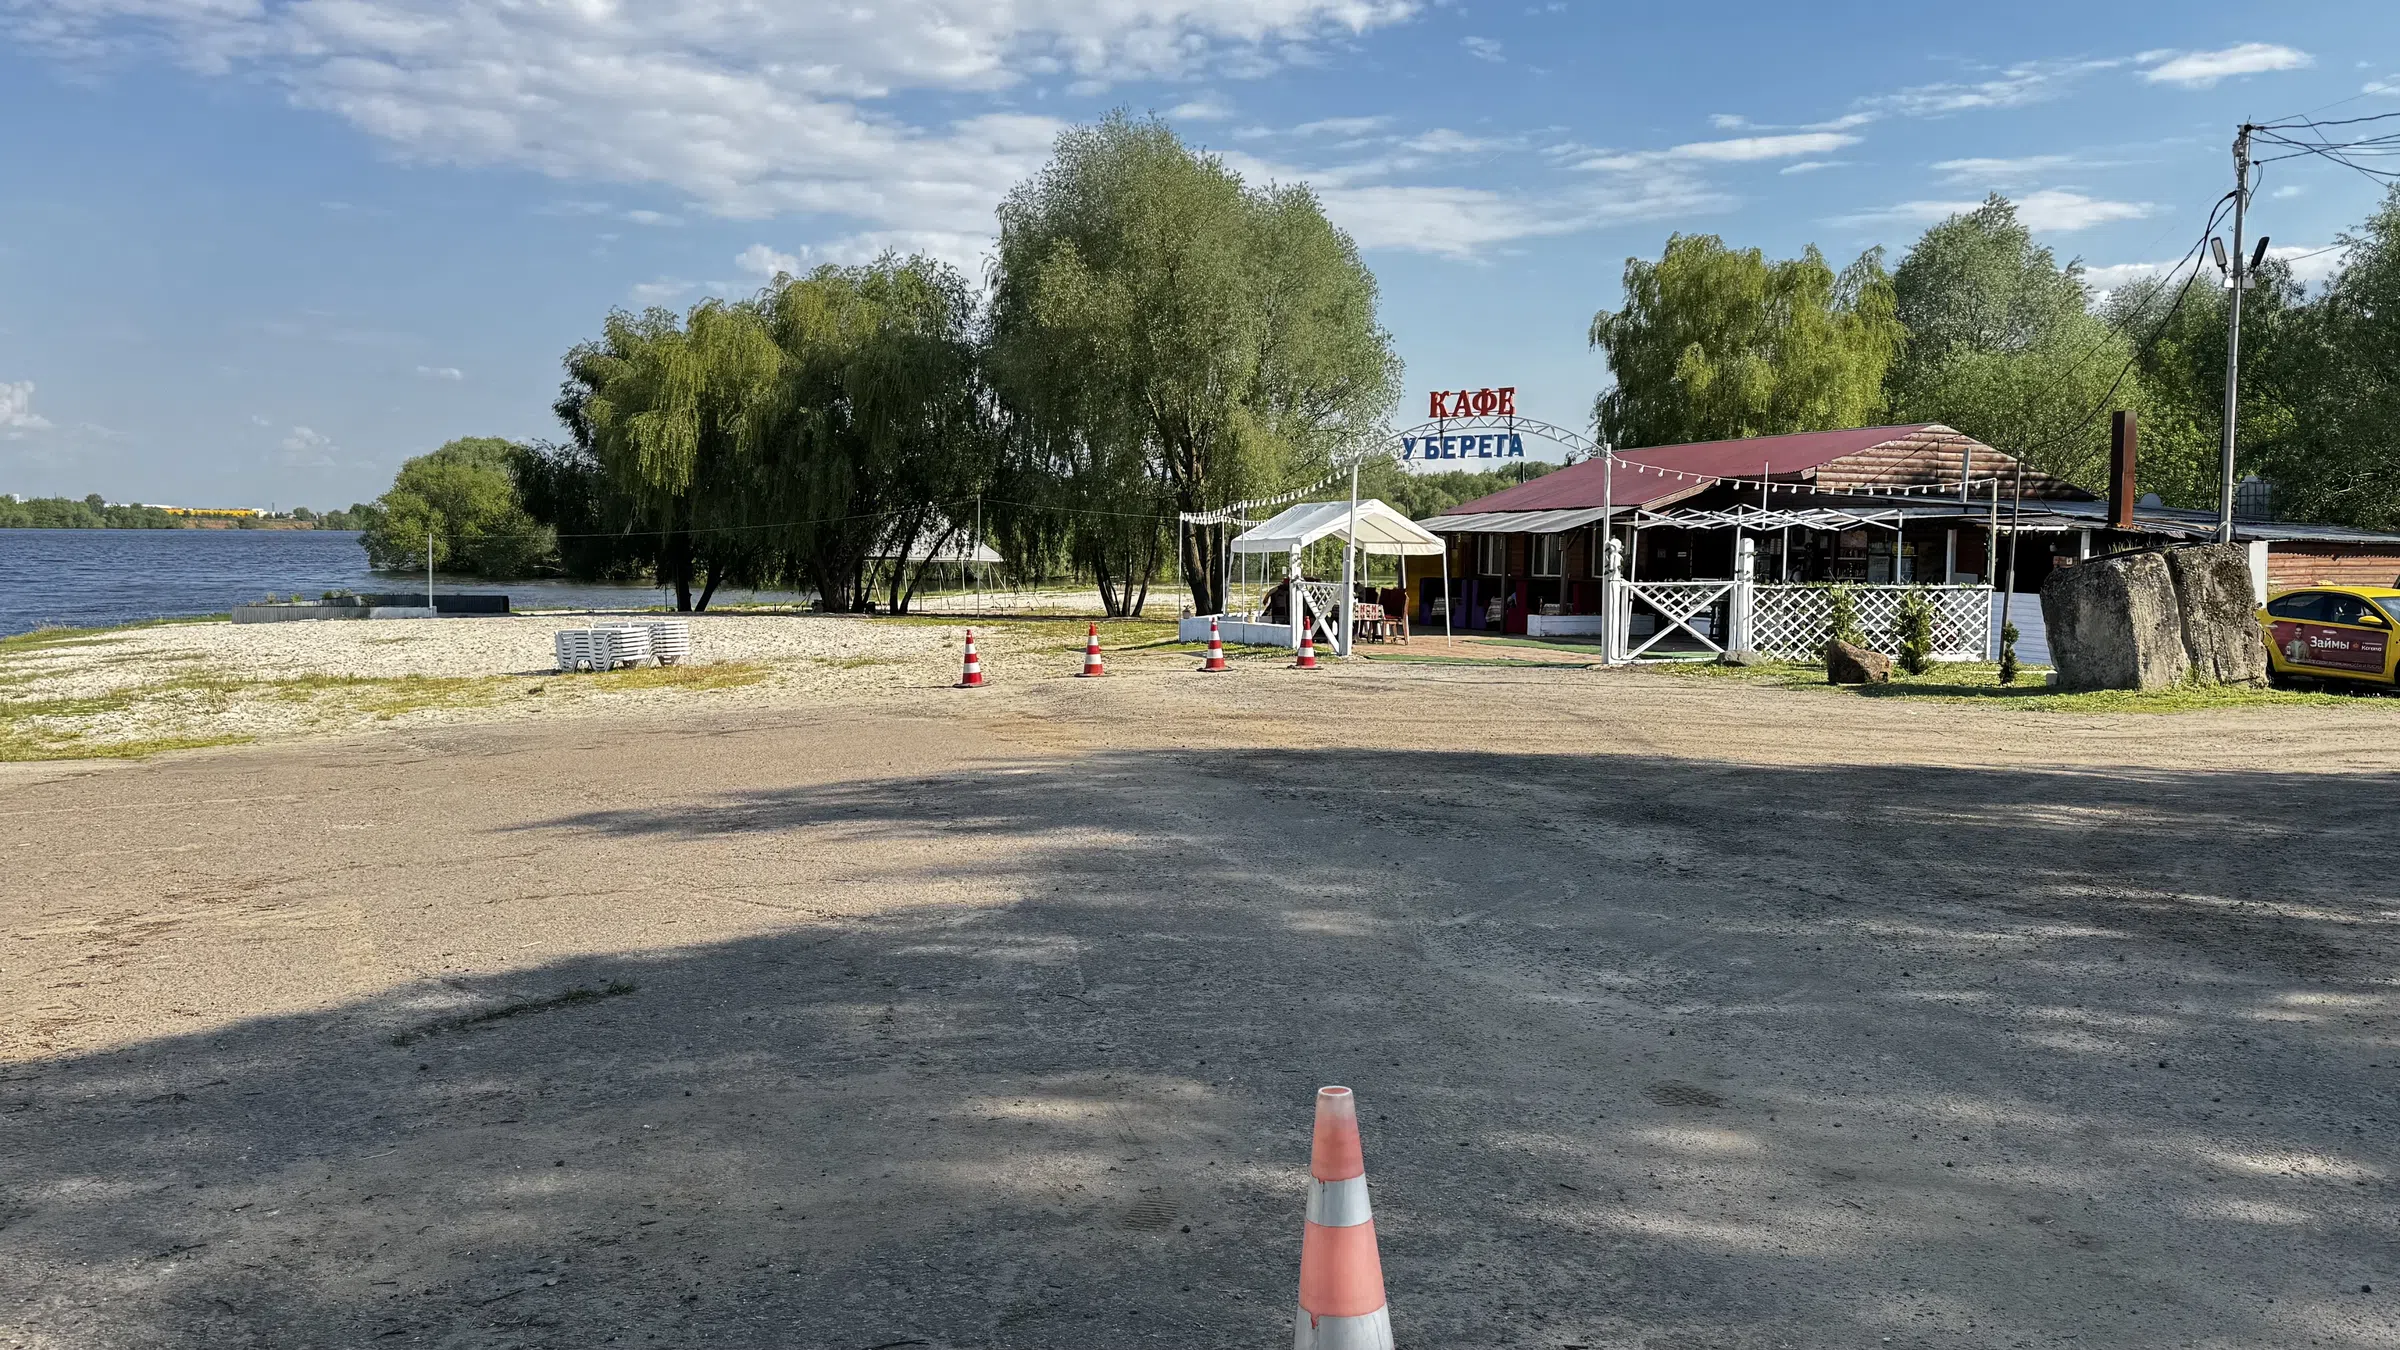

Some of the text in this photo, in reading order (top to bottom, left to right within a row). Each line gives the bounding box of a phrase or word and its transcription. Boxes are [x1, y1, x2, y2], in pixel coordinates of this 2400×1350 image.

[1428, 387, 1516, 418] КАФЕ
[1402, 433, 1526, 460] У БЕРЕГА
[2309, 636, 2350, 650] Займы
